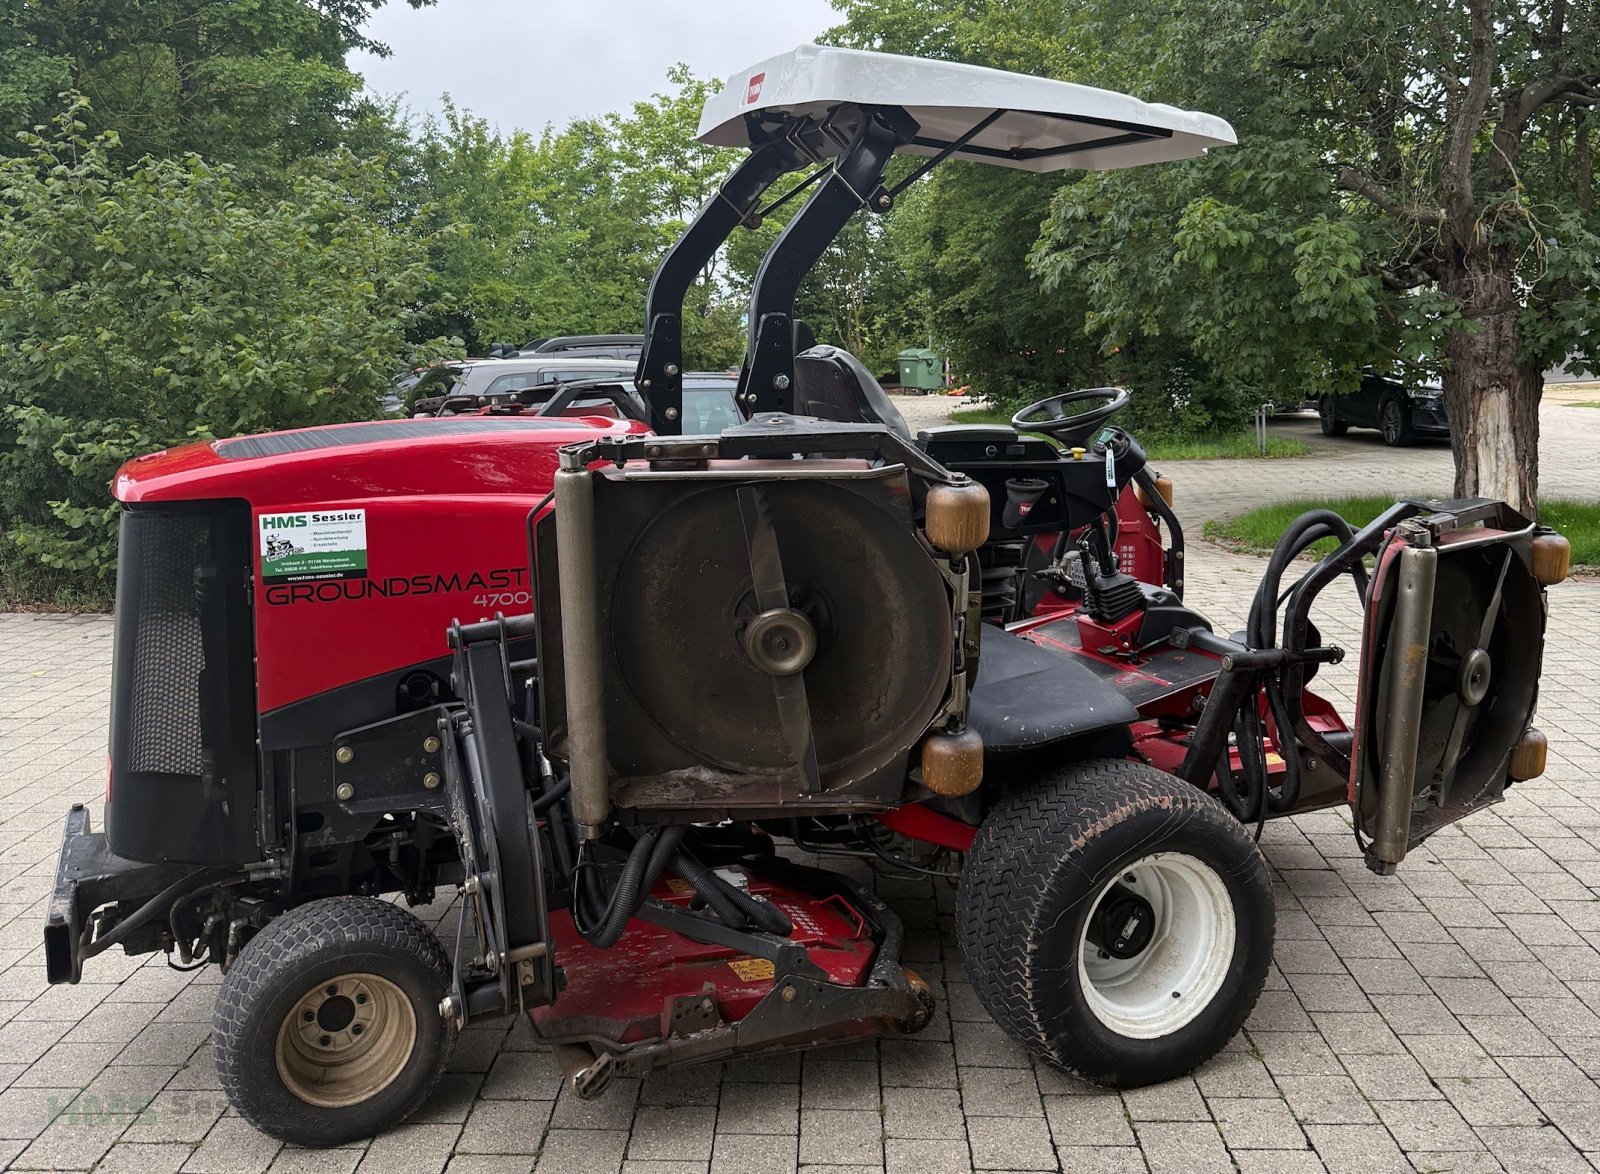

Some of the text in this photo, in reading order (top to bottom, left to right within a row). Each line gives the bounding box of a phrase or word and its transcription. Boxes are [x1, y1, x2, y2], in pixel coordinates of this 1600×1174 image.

[262, 515, 308, 529] HMS
[312, 512, 363, 522] Sessler
[287, 573, 344, 581] www.hms-sessler.de
[265, 567, 532, 606] GROUNDSMAST
